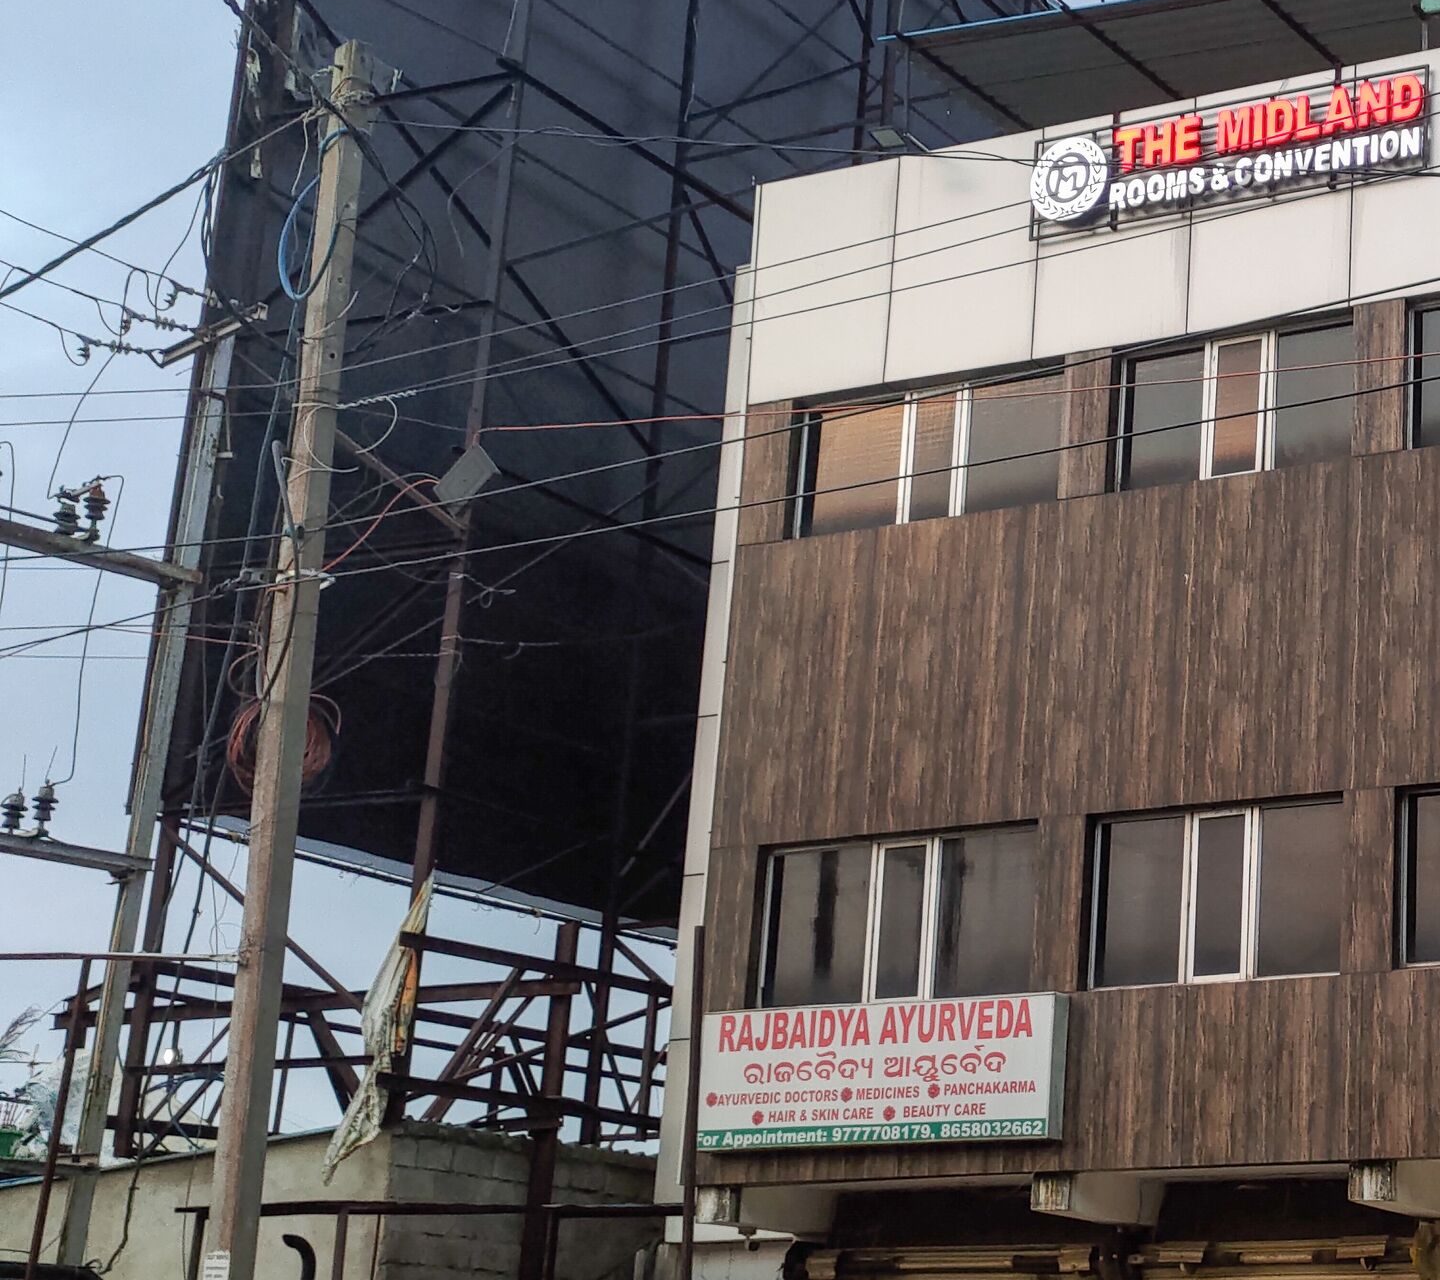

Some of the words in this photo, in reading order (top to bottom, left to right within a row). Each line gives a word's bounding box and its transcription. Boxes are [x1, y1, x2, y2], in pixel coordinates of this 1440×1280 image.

[1114, 111, 1203, 174] THE
[1215, 72, 1425, 156] MIDLAND
[1108, 166, 1205, 210] ROOMS
[1210, 163, 1231, 191] &
[1233, 126, 1421, 184] CONVENTION
[718, 1008, 870, 1053] RAJBAIDYA
[879, 999, 1033, 1045] AYURVEDA
[743, 1050, 873, 1085] ରାଜବୈଦ୍ୟ
[884, 1045, 1007, 1082] ଆୟୁର୍ବେଦ
[717, 1090, 781, 1106] AYURVEDIC
[784, 1088, 839, 1104] DOCTORS
[856, 1085, 920, 1101] MEDICINES
[944, 1080, 1037, 1097] PANCHAKARMA
[768, 1109, 797, 1123] HAIR
[800, 1108, 808, 1122] &
[811, 1107, 840, 1121] SKIN
[843, 1106, 875, 1120] CARE
[903, 1104, 951, 1119] BEAUTY
[953, 1102, 987, 1117] CARE
[722, 1128, 827, 1149] Appointment:
[831, 1125, 936, 1142] 9777708179,
[940, 1120, 1043, 1138] 8658032662
